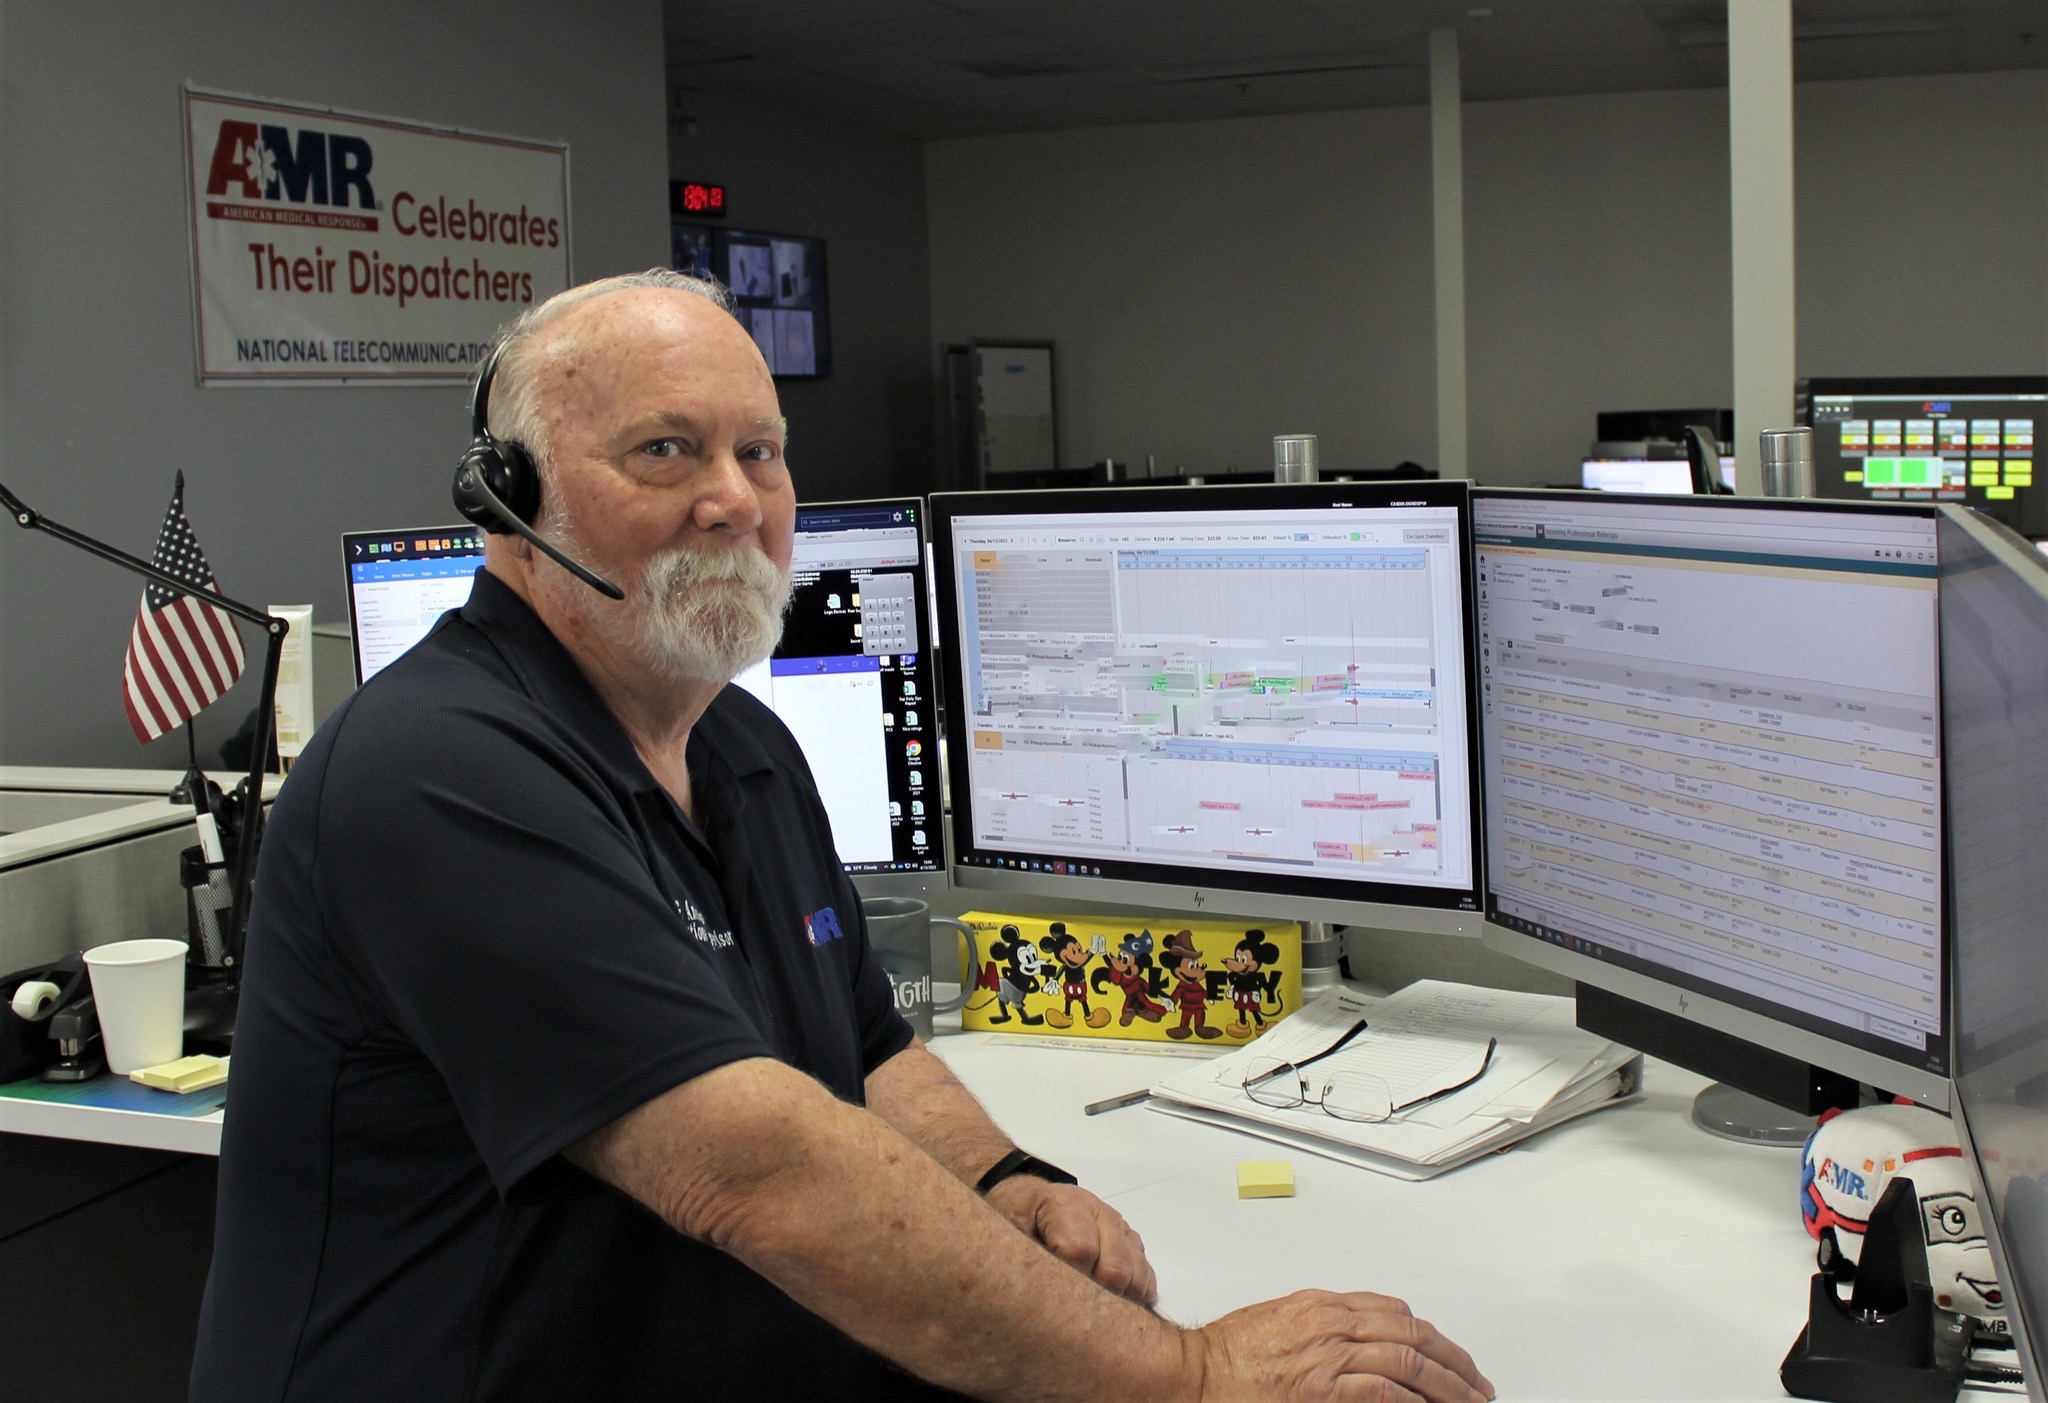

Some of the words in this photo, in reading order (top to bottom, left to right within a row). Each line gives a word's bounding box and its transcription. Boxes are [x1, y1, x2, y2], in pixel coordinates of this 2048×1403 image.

[207, 119, 376, 210] AMR
[222, 206, 272, 221] AMERICAN
[275, 210, 316, 226] MEDICAL
[391, 191, 559, 248] Celebrates
[248, 243, 336, 293] Their
[348, 249, 534, 308] Dispatchers
[236, 339, 328, 363] NATIONAL
[1545, 528, 1567, 539] Incoming
[1566, 529, 1596, 540] Professional
[1596, 531, 1618, 540] Referrals
[1819, 1157, 1868, 1201] AMR
